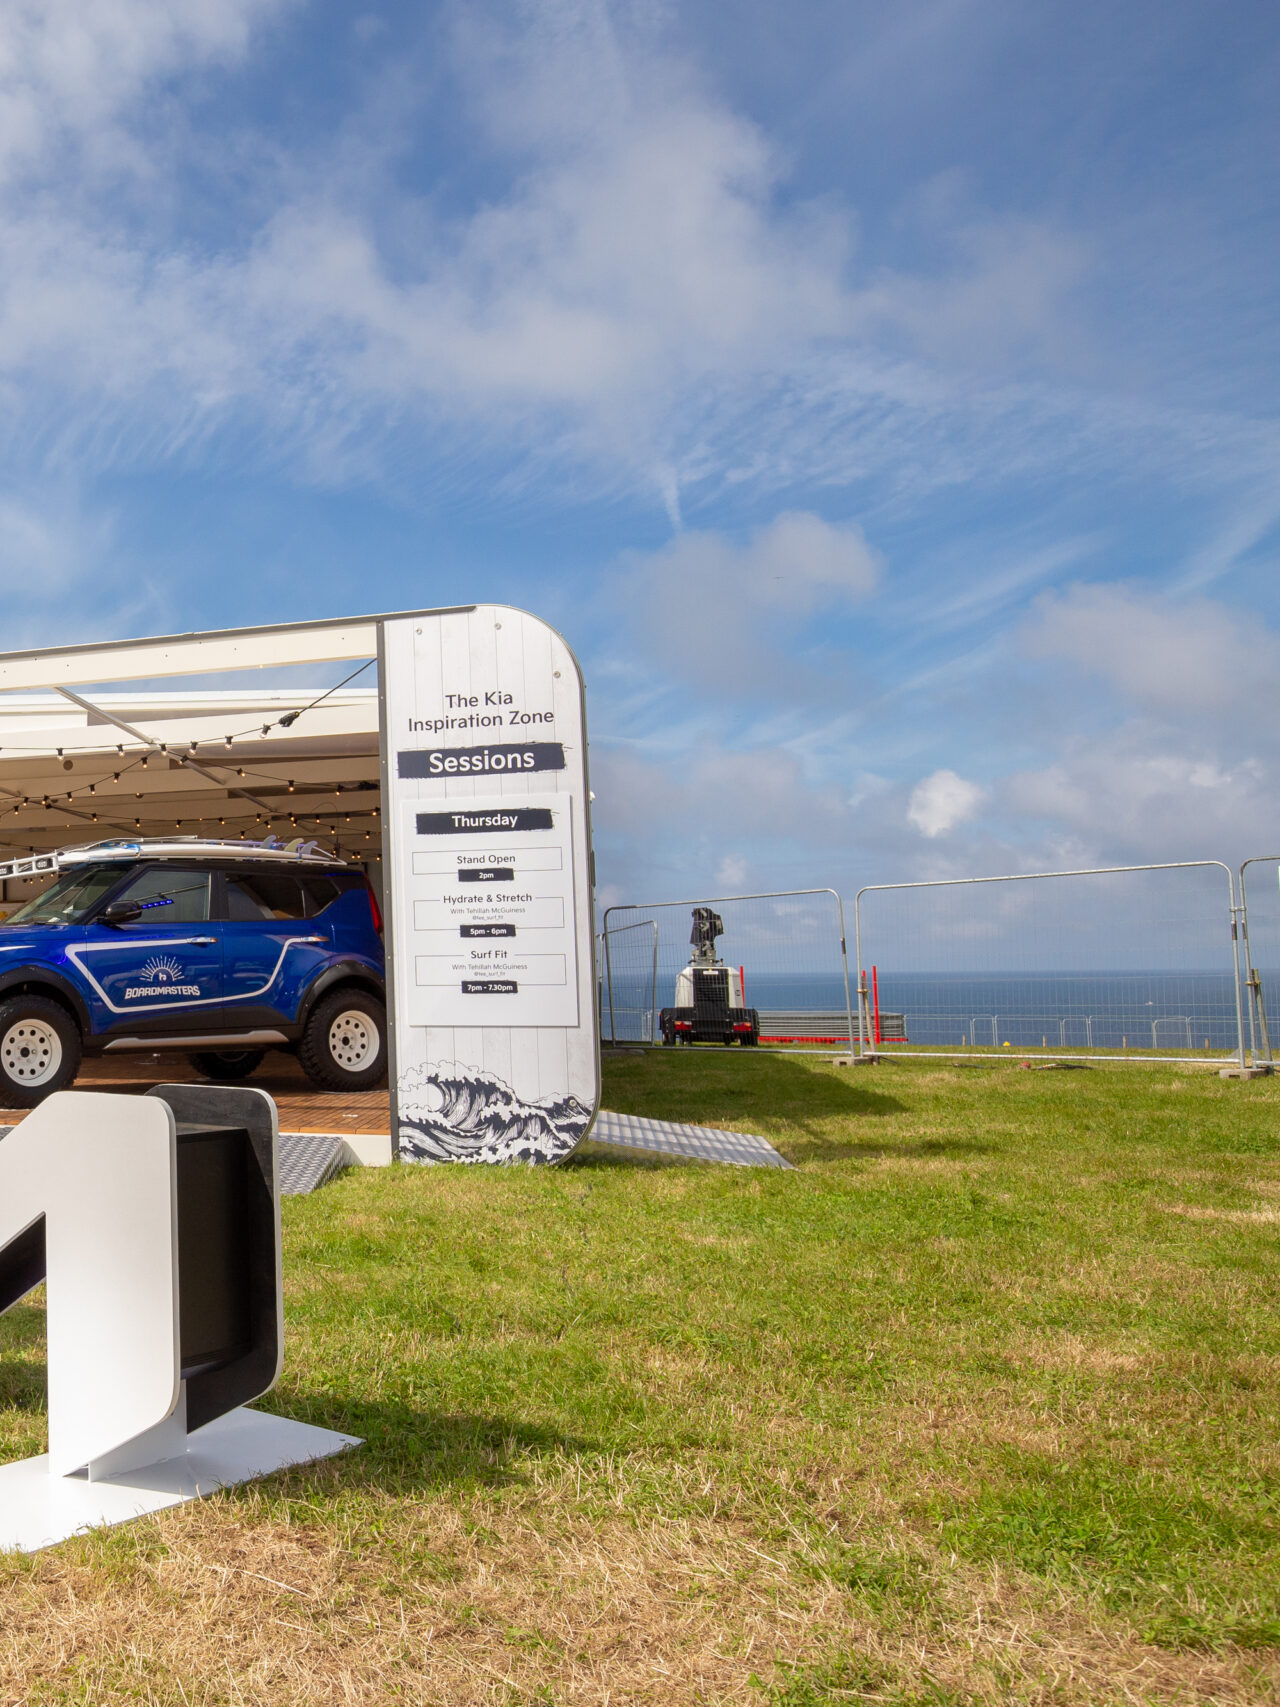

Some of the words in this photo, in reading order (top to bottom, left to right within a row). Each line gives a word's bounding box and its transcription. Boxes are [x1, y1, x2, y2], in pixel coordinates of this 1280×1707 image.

[445, 694, 478, 708] The
[484, 691, 513, 705] Kia
[408, 713, 503, 733] Inspiration
[509, 710, 555, 725] Zone
[429, 750, 535, 773] Sessions
[452, 814, 518, 829] Thursday
[457, 855, 485, 864] Stand
[488, 854, 516, 865] Open
[478, 872, 494, 880] 2pm
[443, 895, 484, 905] Hydrate
[486, 894, 493, 903] &
[496, 893, 532, 903] Stretch
[470, 928, 486, 936] 5pm
[470, 950, 492, 959] Surf
[494, 950, 508, 959] Fit
[124, 985, 201, 1000] BOARDMASTERS
[467, 984, 483, 992] 7pm
[488, 984, 513, 992] 7.30pm
